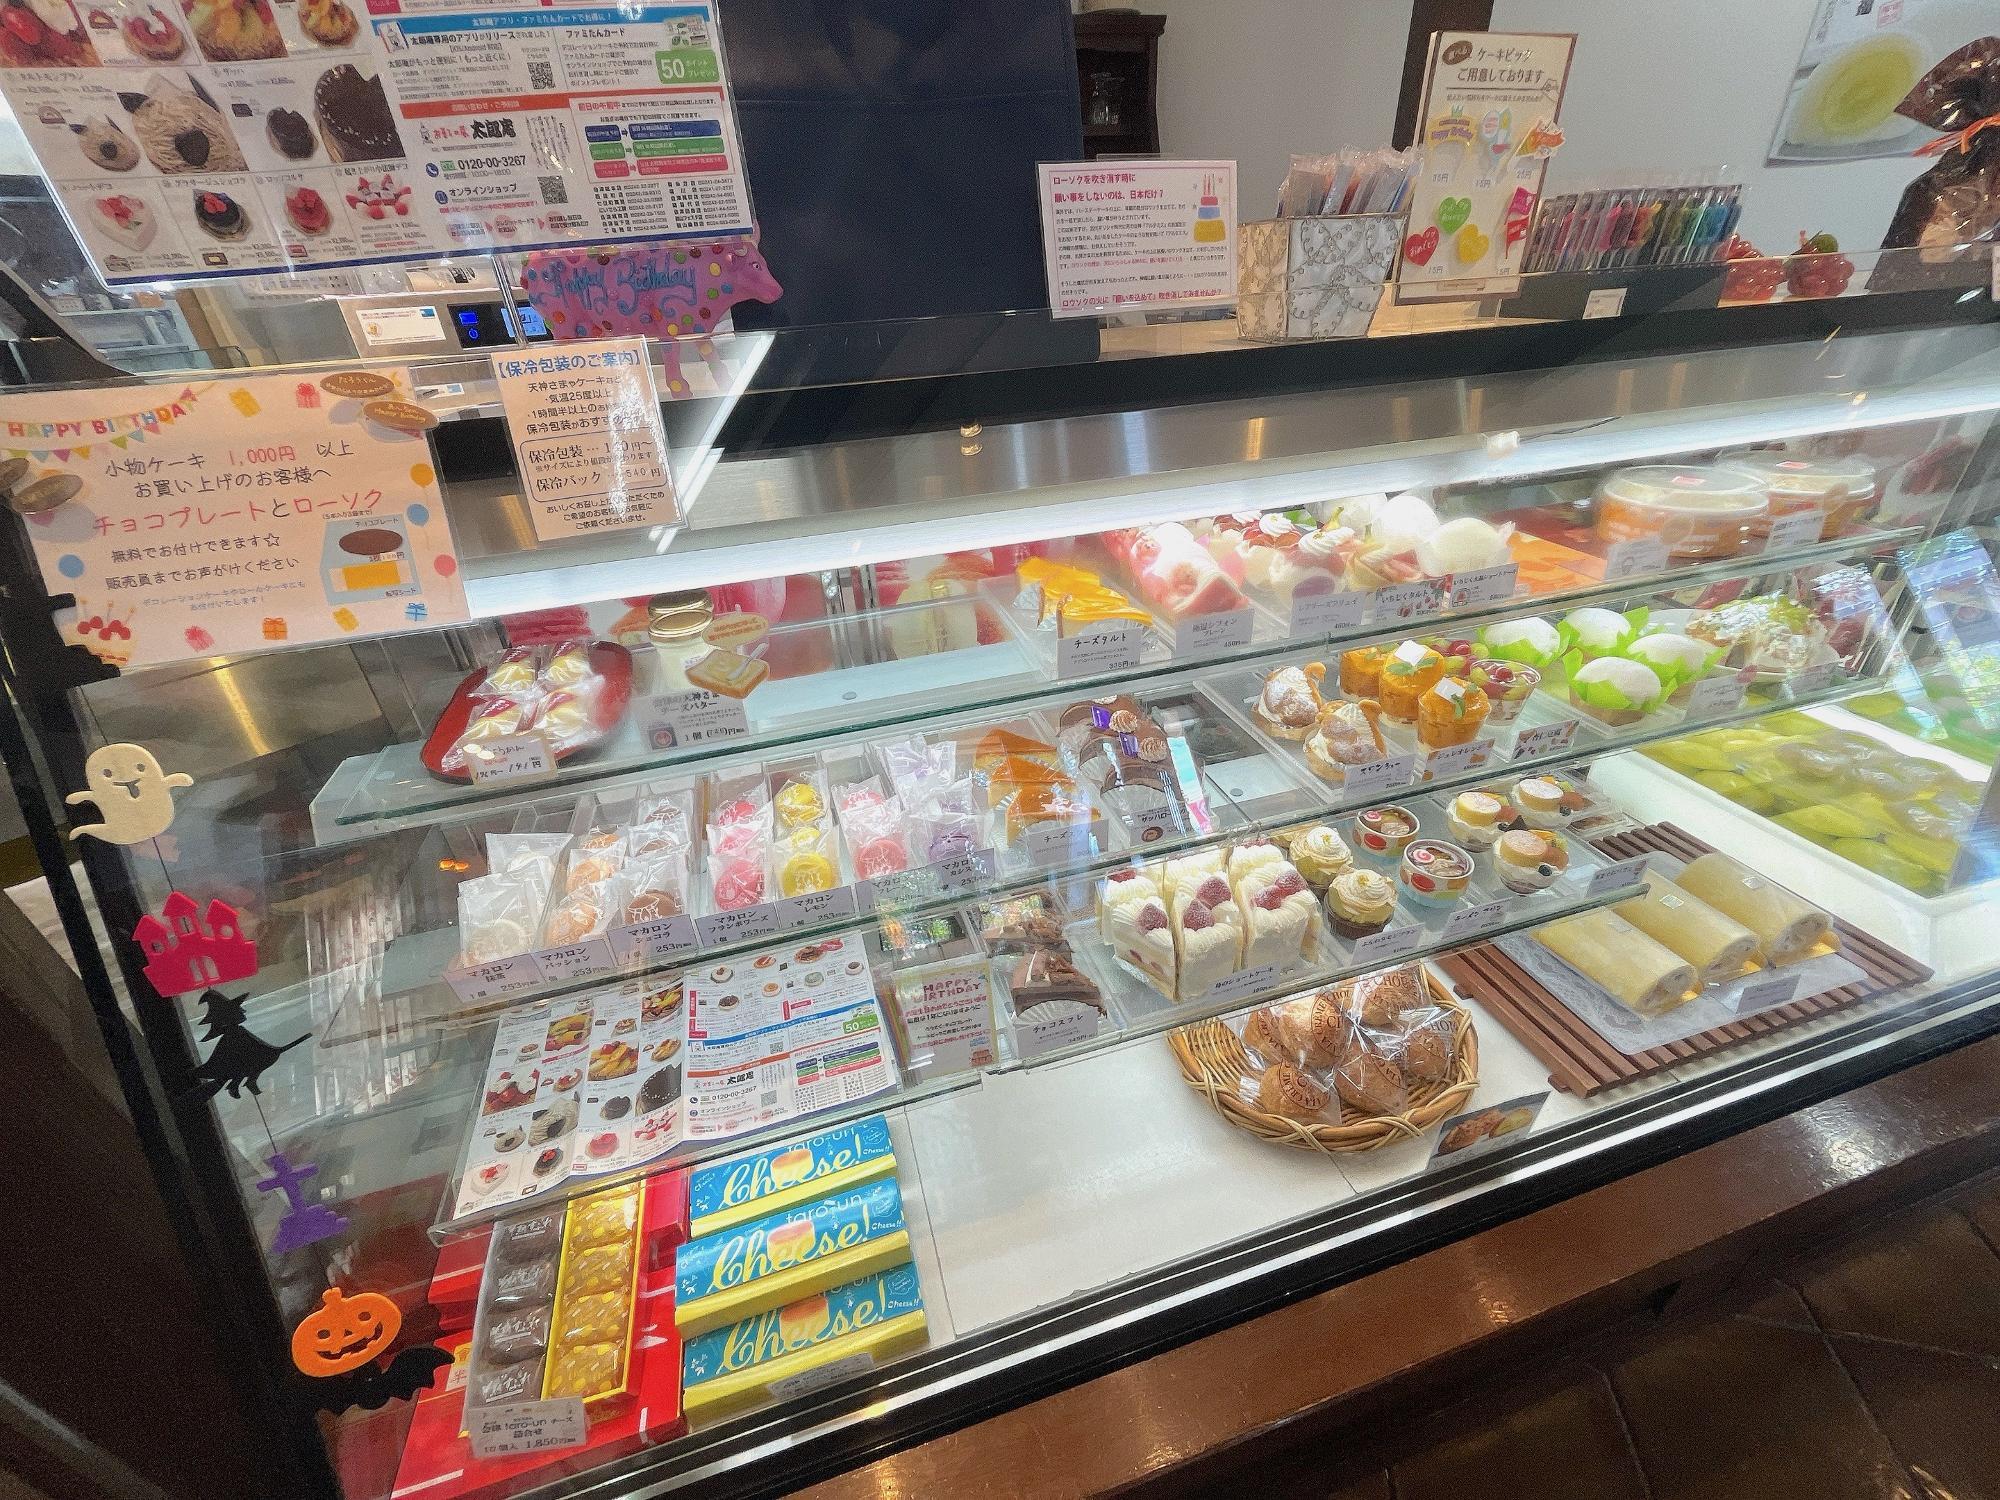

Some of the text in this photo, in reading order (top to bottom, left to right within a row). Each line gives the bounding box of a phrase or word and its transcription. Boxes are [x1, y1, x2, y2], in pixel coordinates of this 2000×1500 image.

[661, 59, 686, 79] 50
[1457, 67, 1544, 83] ご用意しております
[457, 155, 527, 171] 0120-00-3267
[1053, 173, 1136, 185] ローソクを吹き消す時に
[449, 183, 517, 197] オンラインショップ
[497, 350, 641, 378] 【保冷包装のご案内】
[8, 400, 197, 438] HAPPY BIRTHDAY
[105, 440, 355, 478] 小物ケーキ 1,000円 以上
[134, 467, 332, 499] お買い上げのお客様へ
[94, 488, 384, 538] チョコプレートとローソク
[106, 557, 300, 591] 販売員までお声がけください
[1074, 633, 1127, 649] チーズタルト
[950, 867, 973, 877] カシス
[794, 894, 834, 907] マカロン
[804, 903, 829, 913] レモン
[708, 915, 770, 934] フランボワーズ
[715, 911, 758, 924] マカロン
[628, 923, 673, 937] マカロン
[635, 931, 671, 944] ショコラ
[541, 948, 587, 960] マカロン
[467, 962, 514, 978] マカロン
[545, 955, 591, 970] パッション
[923, 978, 972, 992] HAPPY
[845, 1022, 860, 1034] 50
[1033, 1014, 1083, 1033] チョコスフレ
[787, 1128, 856, 1153] taro-un
[786, 1193, 863, 1226] taro-un
